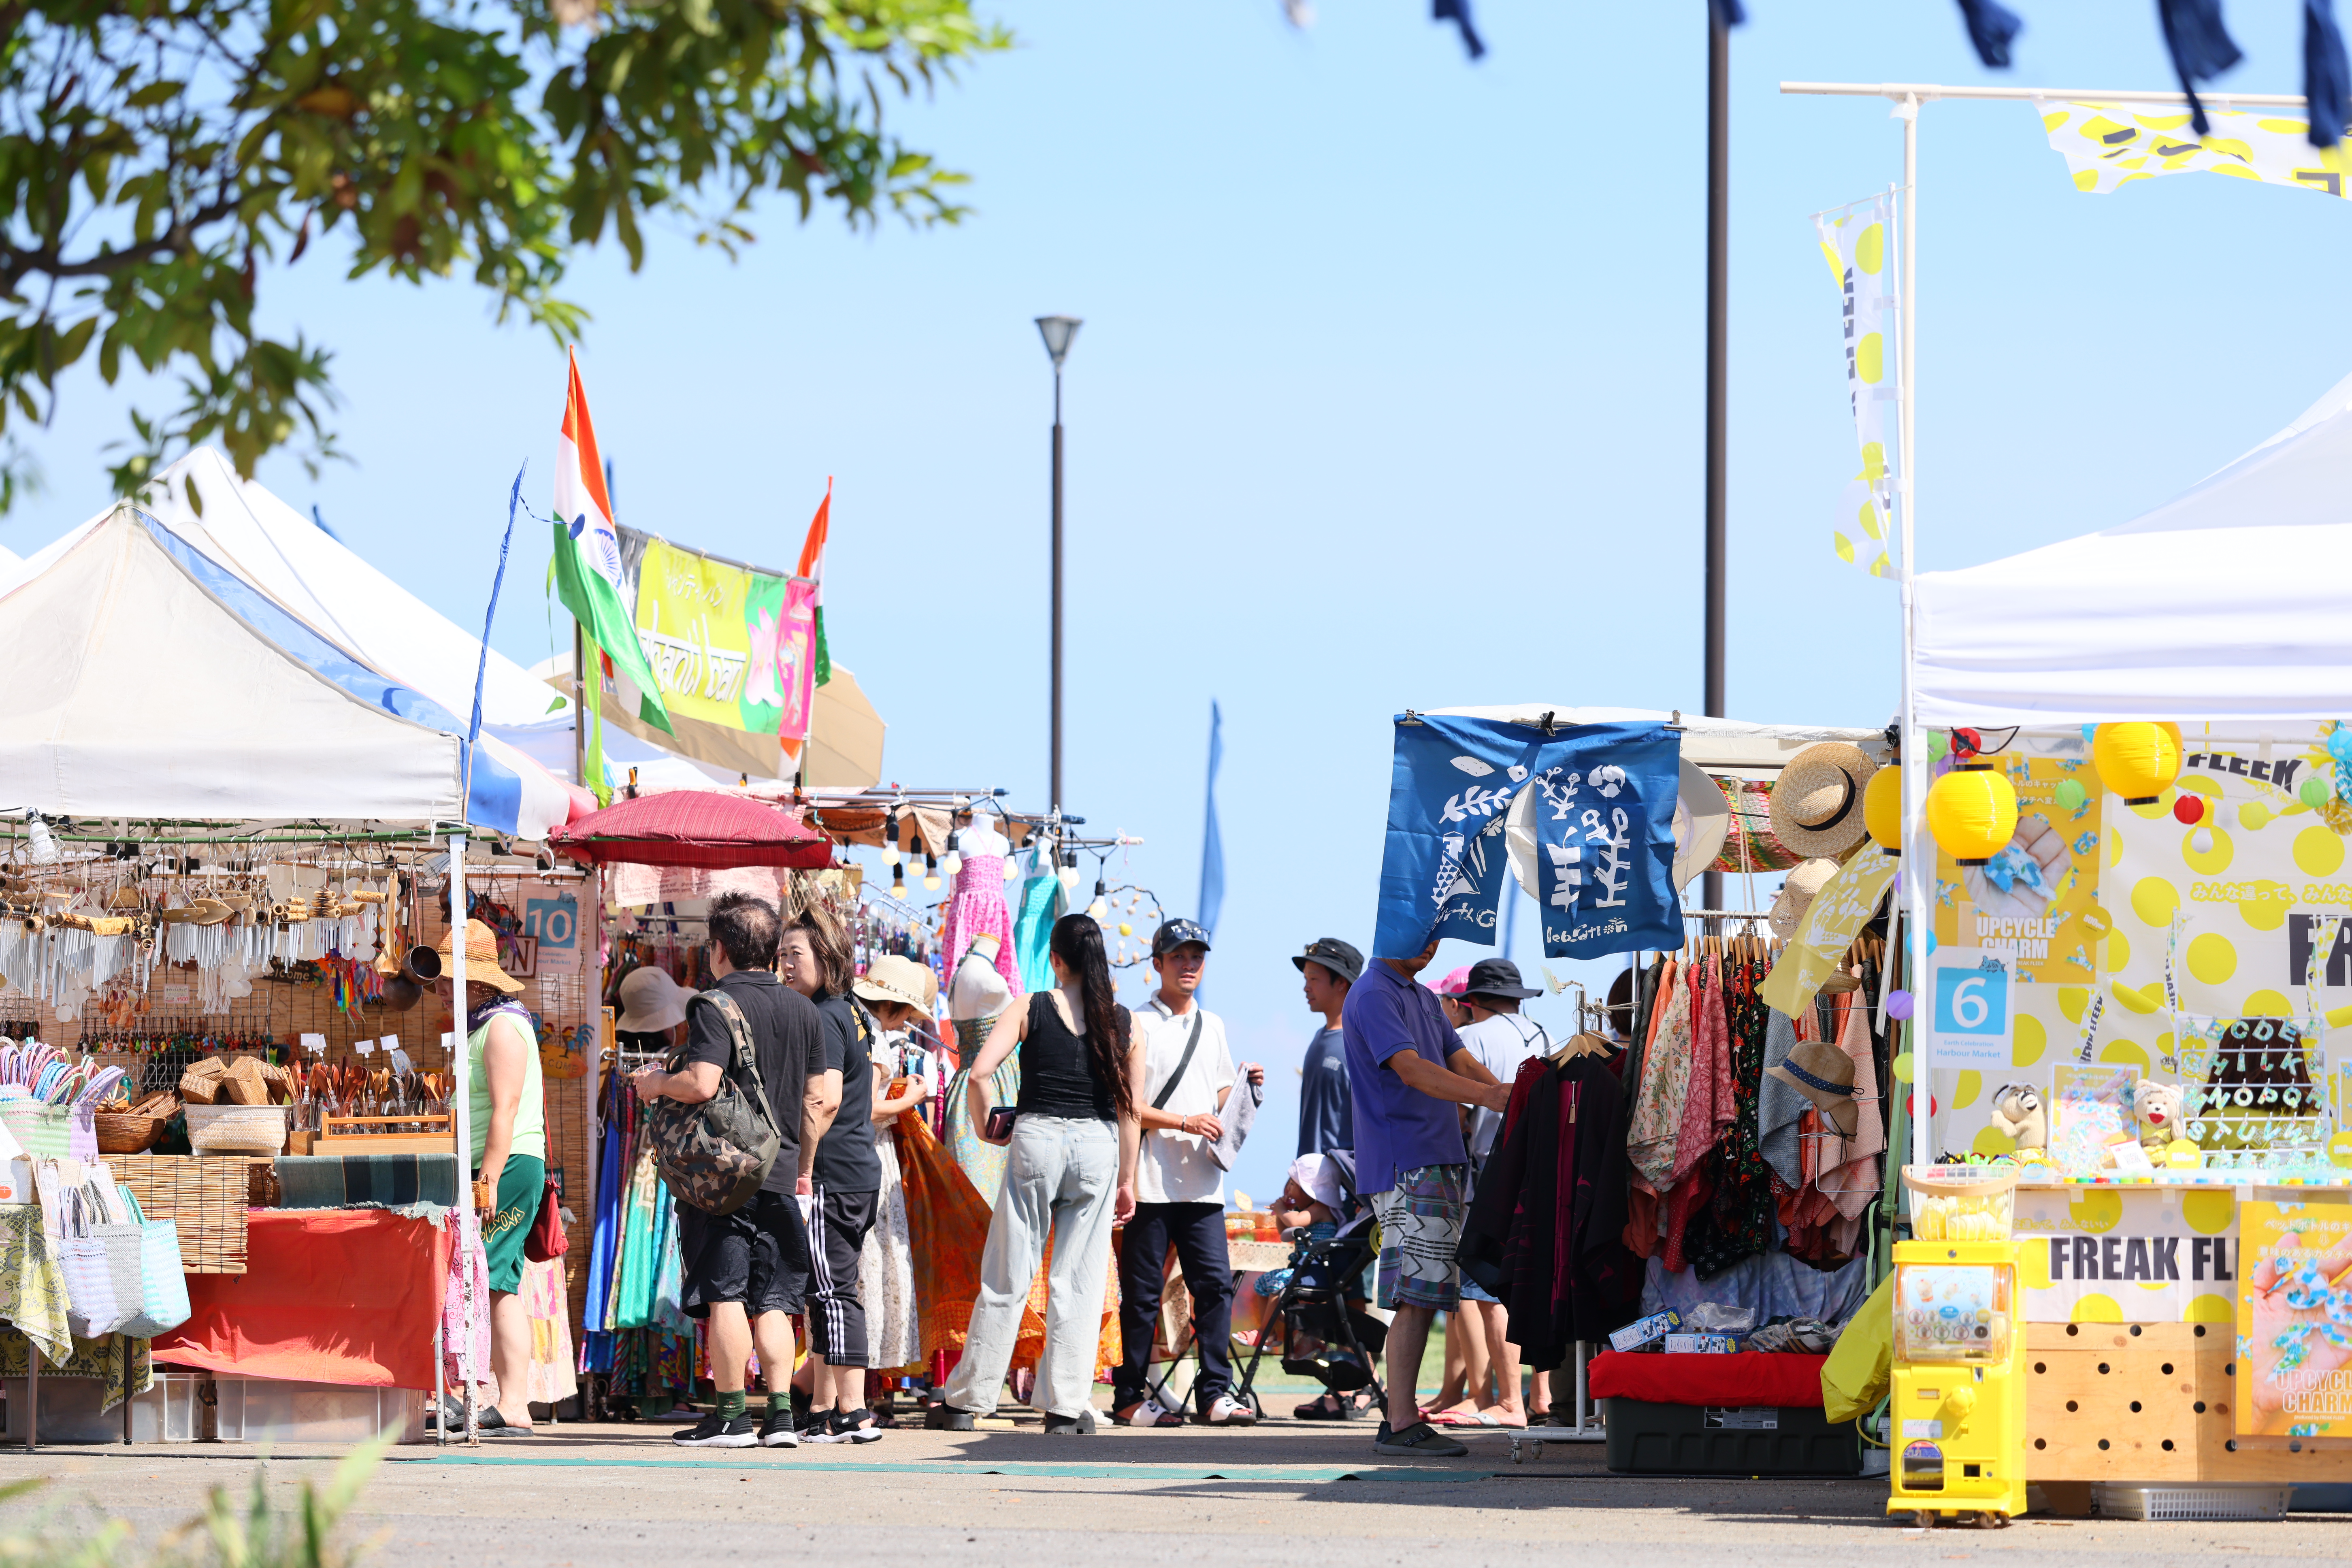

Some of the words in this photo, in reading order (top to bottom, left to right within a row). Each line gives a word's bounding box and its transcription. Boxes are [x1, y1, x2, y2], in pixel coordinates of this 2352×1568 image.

[639, 599, 703, 696] hanti
[701, 613, 747, 703] ban
[2187, 753, 2303, 795] FLEEK
[2192, 884, 2295, 901] みんな違って、
[529, 908, 572, 943] 10
[1976, 916, 2056, 938] UPCYCLE
[268, 968, 310, 980] lcome
[1952, 977, 1988, 1028] 6
[1937, 1048, 1969, 1057] Harbour
[1972, 1050, 2001, 1059] Market
[541, 1057, 578, 1073] LCOME
[2051, 1236, 2180, 1280] FREAK
[2192, 1237, 2240, 1280] FL
[722, 1421, 731, 1434] PUMA
